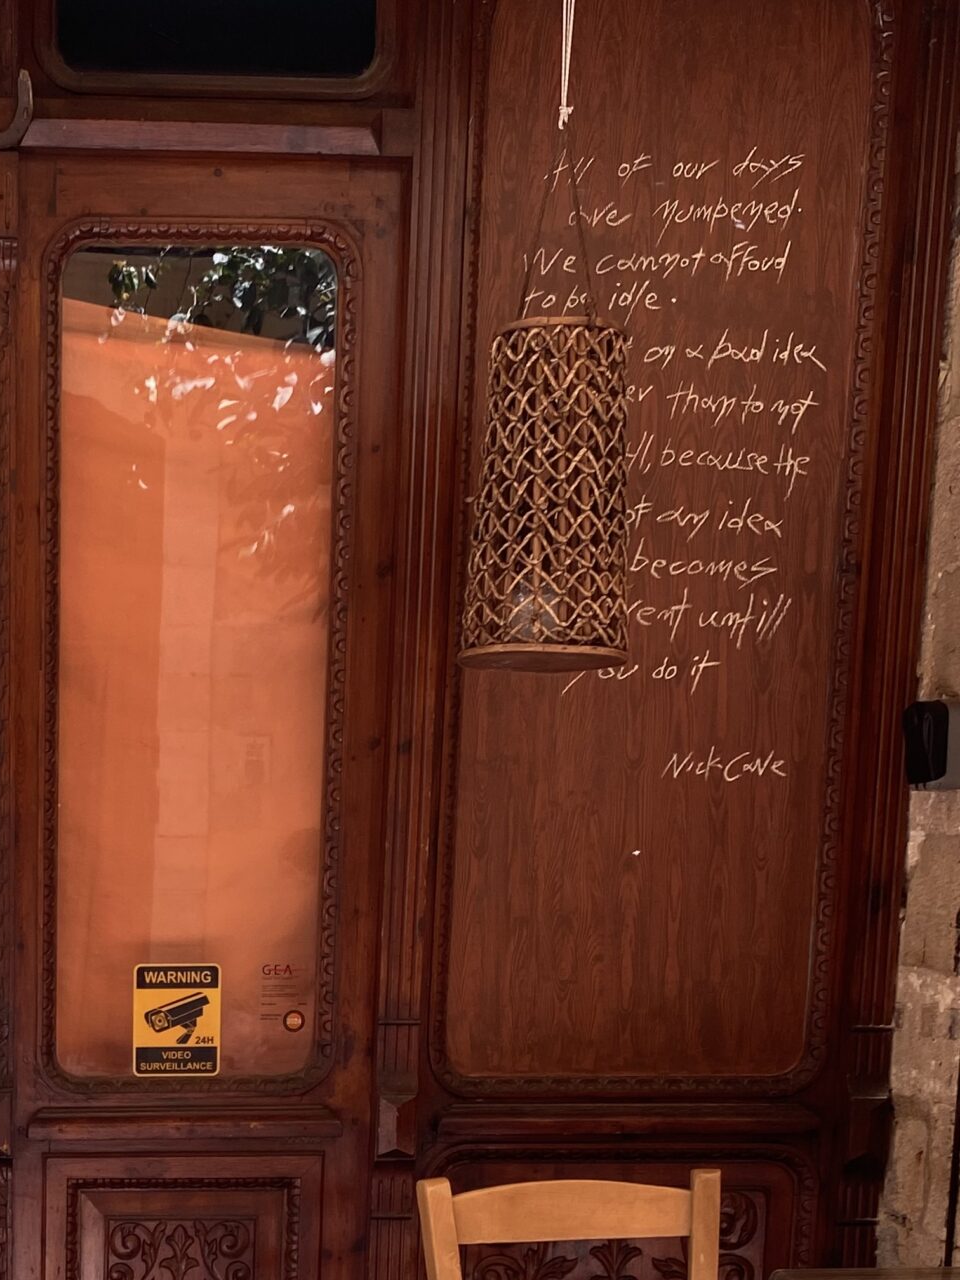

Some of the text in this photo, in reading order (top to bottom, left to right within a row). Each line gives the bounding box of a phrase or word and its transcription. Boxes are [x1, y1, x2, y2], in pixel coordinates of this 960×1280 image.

[617, 152, 653, 187] of
[673, 159, 720, 180] our
[732, 146, 806, 190] days
[522, 246, 577, 276] We
[596, 246, 706, 279] cannot
[608, 281, 677, 326] idle.
[686, 344, 704, 360] a
[772, 331, 827, 372] idea
[666, 380, 737, 428] than
[740, 383, 765, 425] to
[660, 438, 769, 475] because
[773, 443, 811, 502] the
[718, 497, 784, 539] idea
[629, 537, 778, 592] becomes
[698, 592, 792, 649] untill
[651, 656, 678, 680] do
[690, 650, 722, 696] it
[143, 970, 212, 985] WARNING
[161, 1050, 192, 1060] VIDEO
[194, 1036, 215, 1045] 24H
[139, 1061, 214, 1071] SURVEILLANCE
